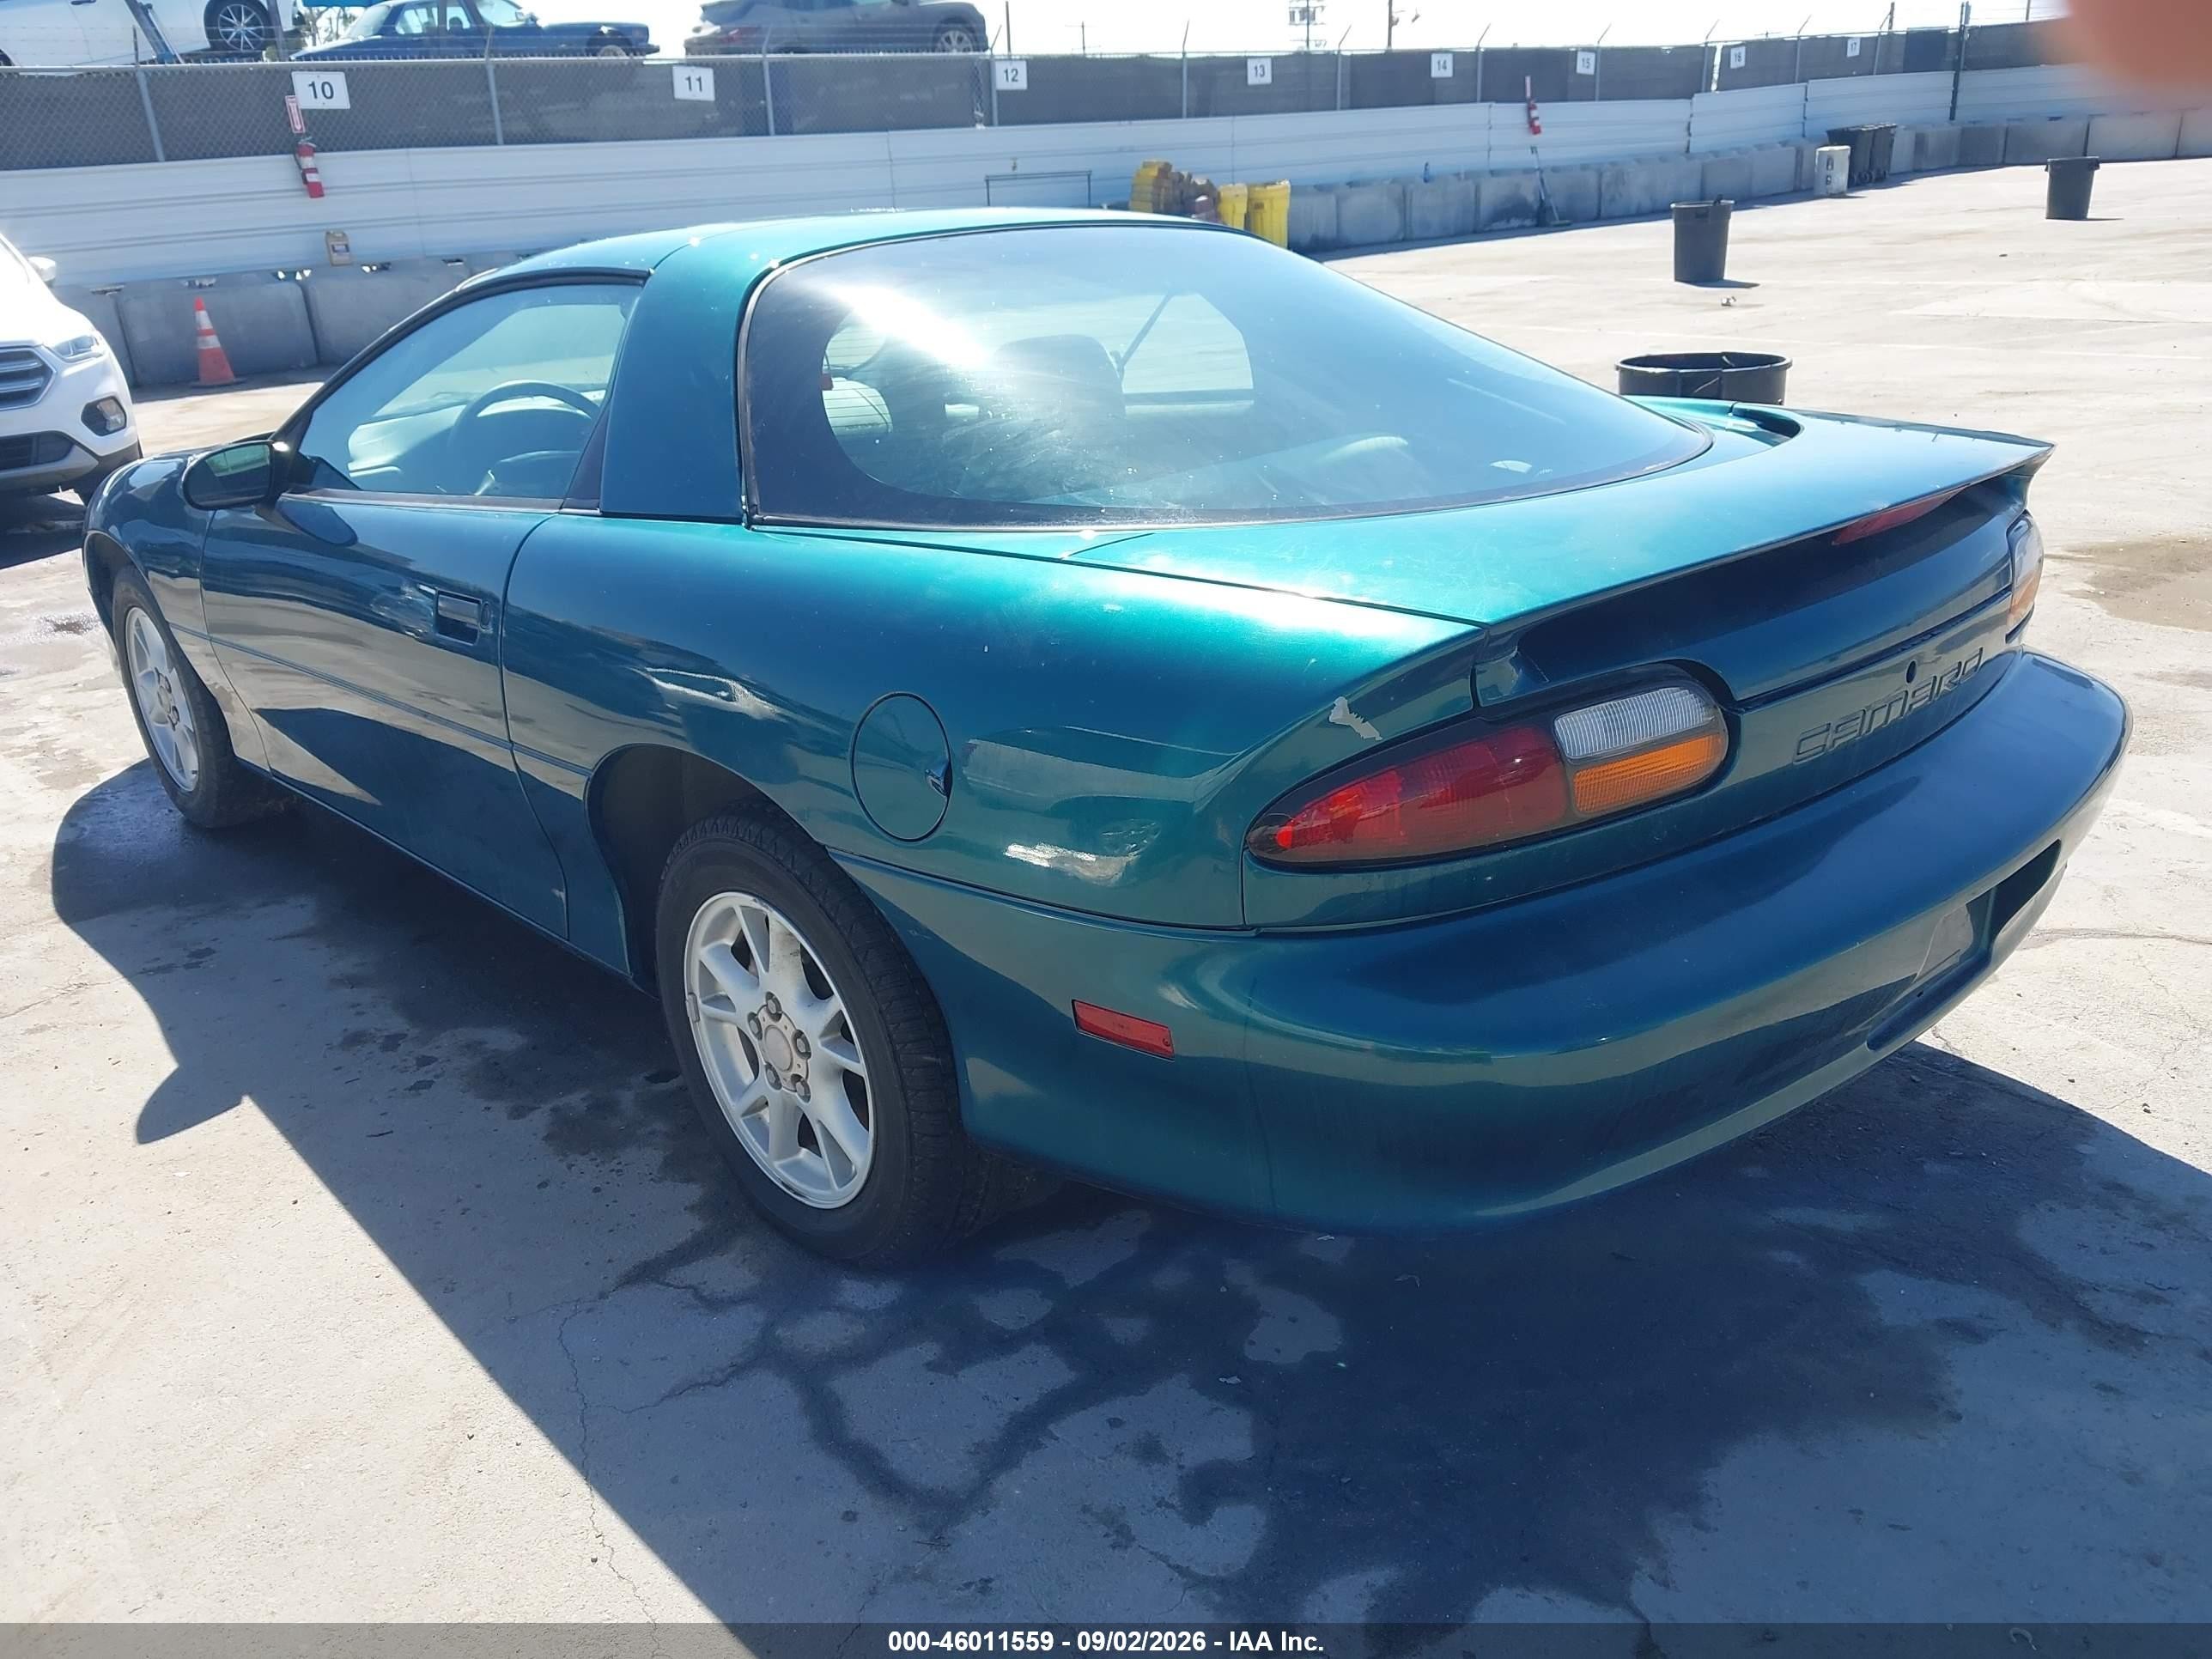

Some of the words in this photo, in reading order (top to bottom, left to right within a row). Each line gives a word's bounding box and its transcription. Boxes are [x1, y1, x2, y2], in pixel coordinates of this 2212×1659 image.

[1437, 59, 1448, 70] 14
[1581, 57, 1590, 69] 15
[1004, 68, 1018, 82] 12
[1254, 64, 1265, 77] 13
[307, 81, 334, 100] 10
[684, 76, 702, 92] 11
